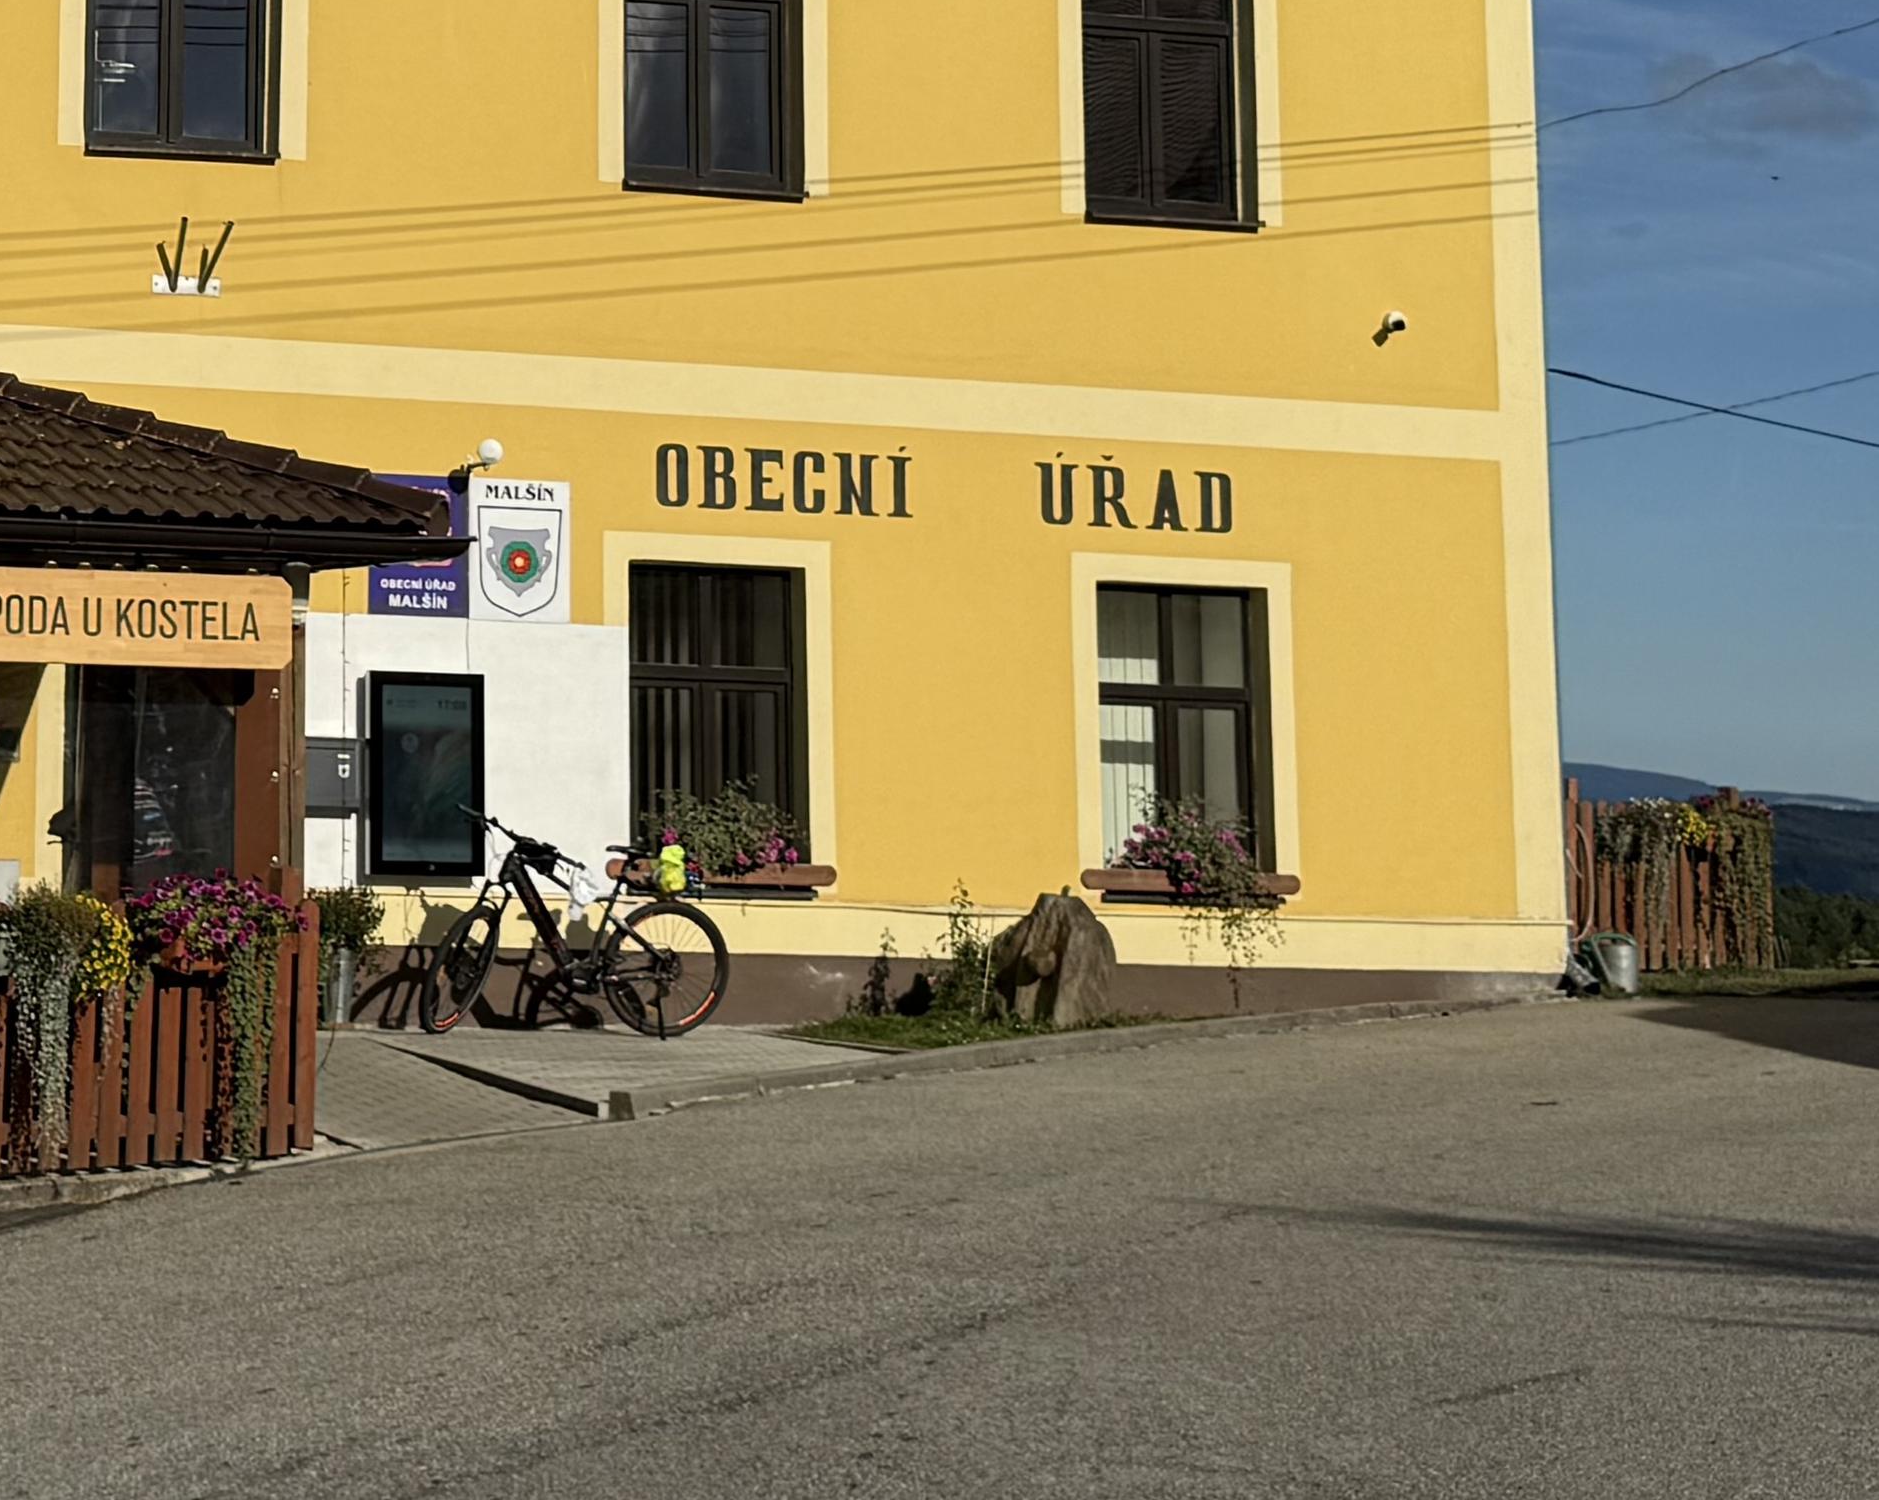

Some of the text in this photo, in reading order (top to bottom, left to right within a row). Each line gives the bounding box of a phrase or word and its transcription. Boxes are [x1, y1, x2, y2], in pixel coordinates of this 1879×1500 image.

[485, 483, 555, 502] MALŠÍN
[656, 444, 1233, 534] OBECNÍ ÚŘAD
[380, 577, 457, 591] OBECNÍ ÚŘAD
[388, 592, 448, 609] MALŠÍN
[83, 598, 101, 636] U
[116, 599, 260, 642] KOSTELA
